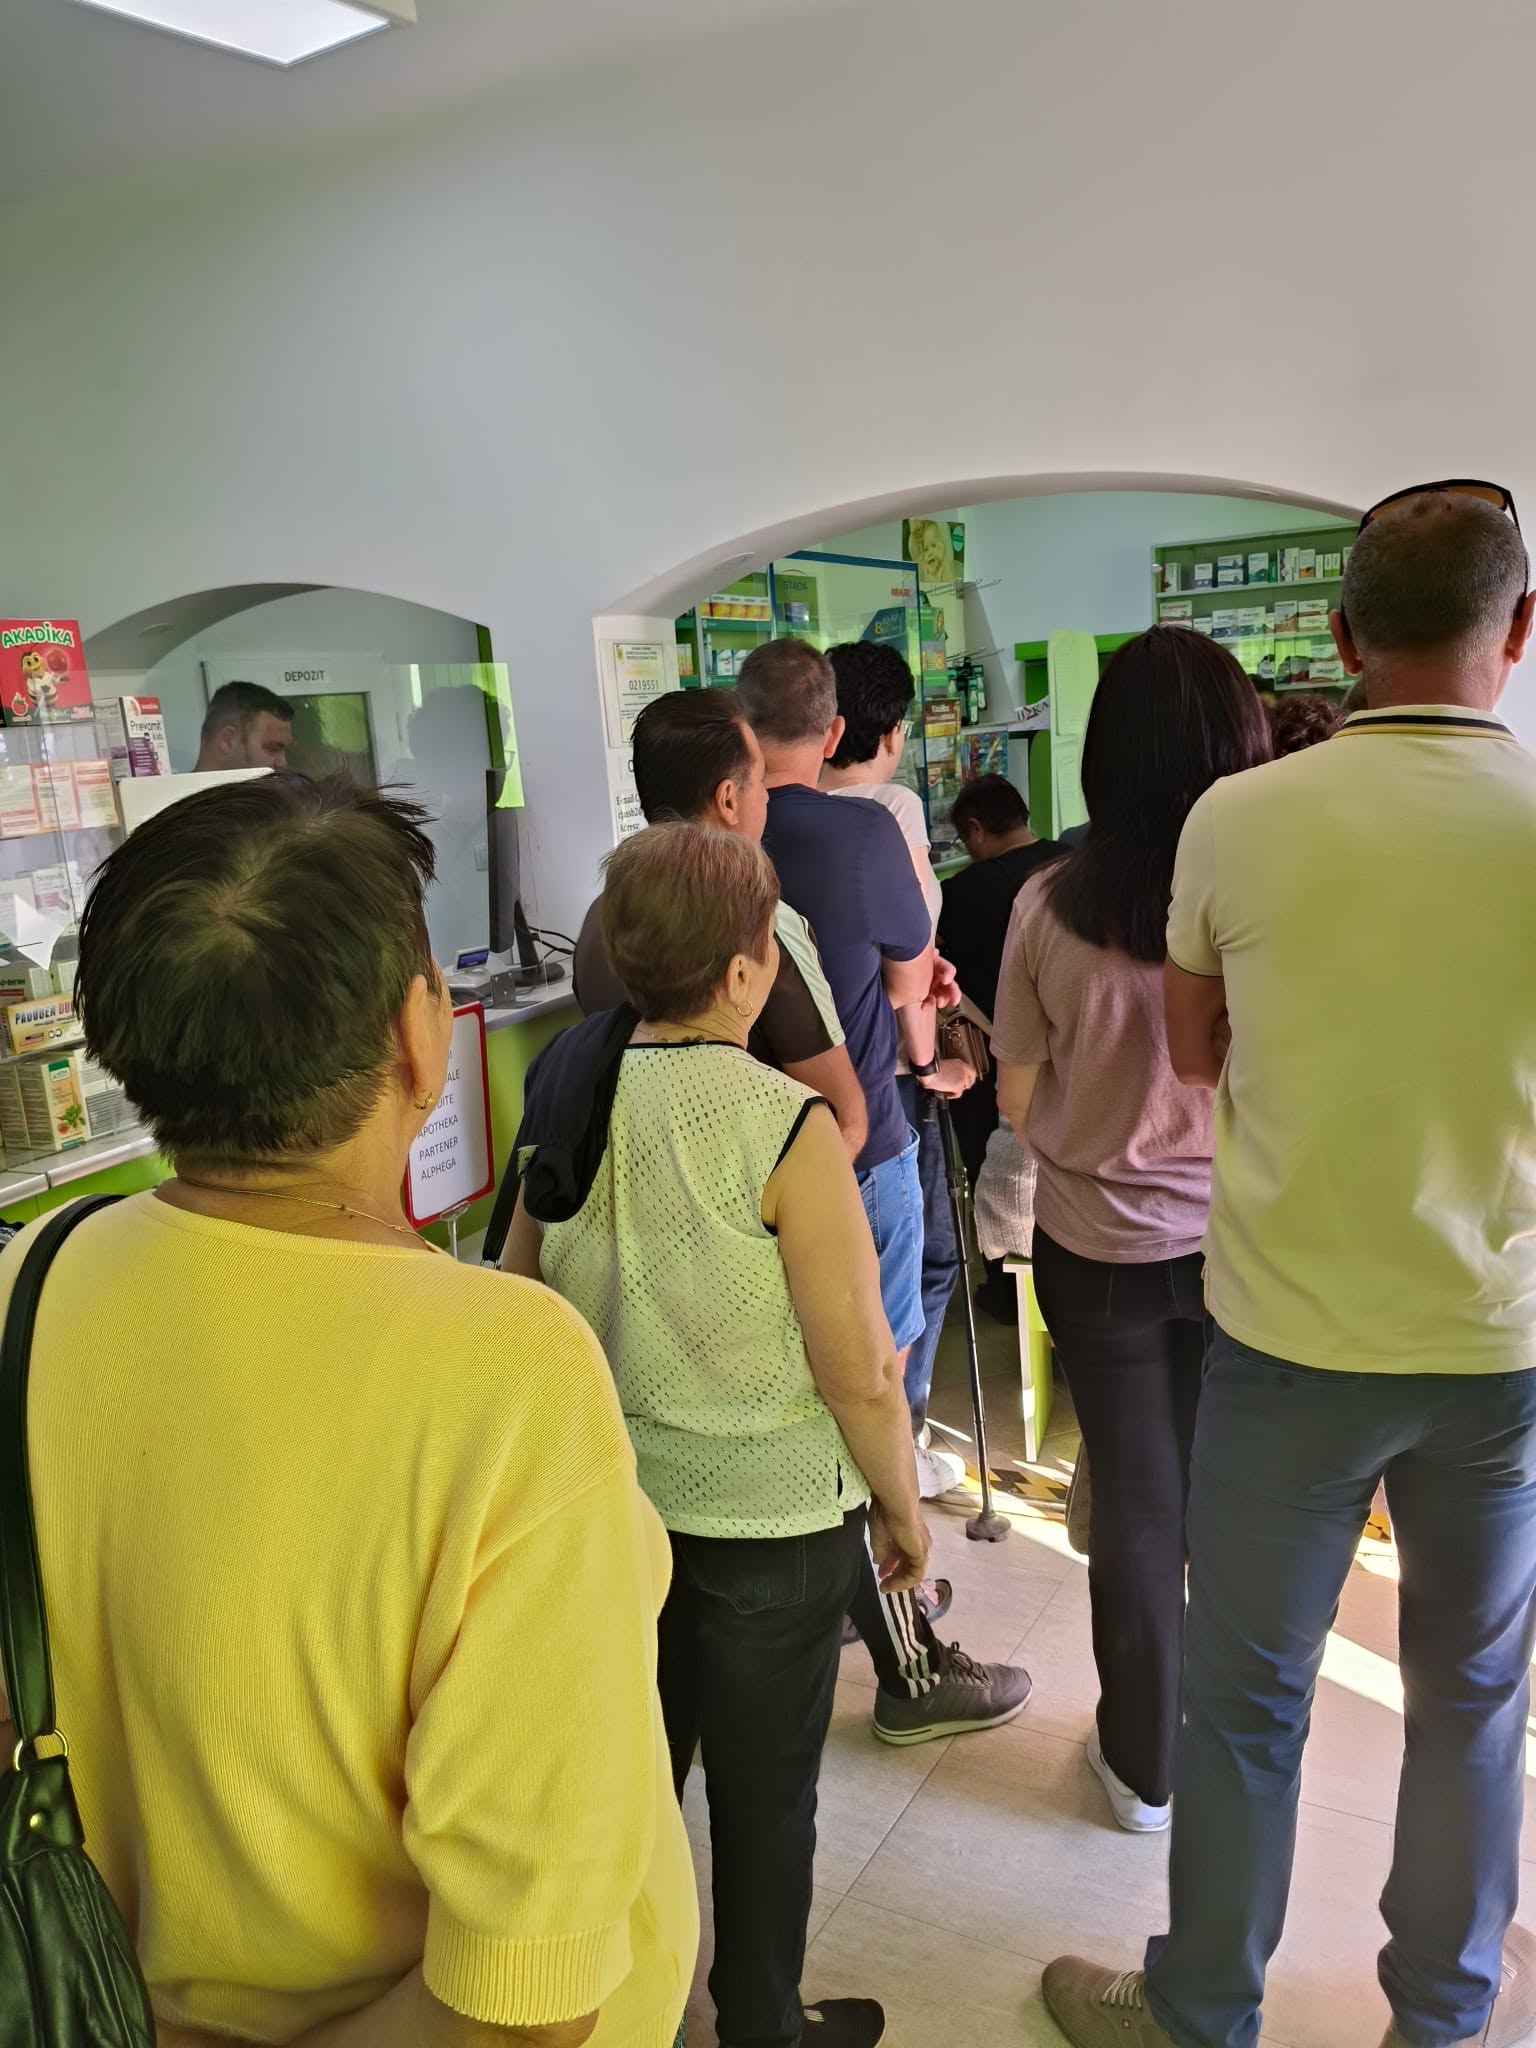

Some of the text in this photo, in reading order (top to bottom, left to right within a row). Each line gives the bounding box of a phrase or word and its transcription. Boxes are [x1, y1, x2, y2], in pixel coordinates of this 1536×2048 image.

[284, 670, 326, 682] DEPOZIT
[629, 679, 659, 691] 0219551
[447, 1068, 460, 1083] ALE
[437, 1093, 455, 1110] UITE
[417, 1114, 459, 1139] APOTHEKA
[419, 1136, 459, 1161] PARTENER
[421, 1158, 457, 1181] ALPHEGA
